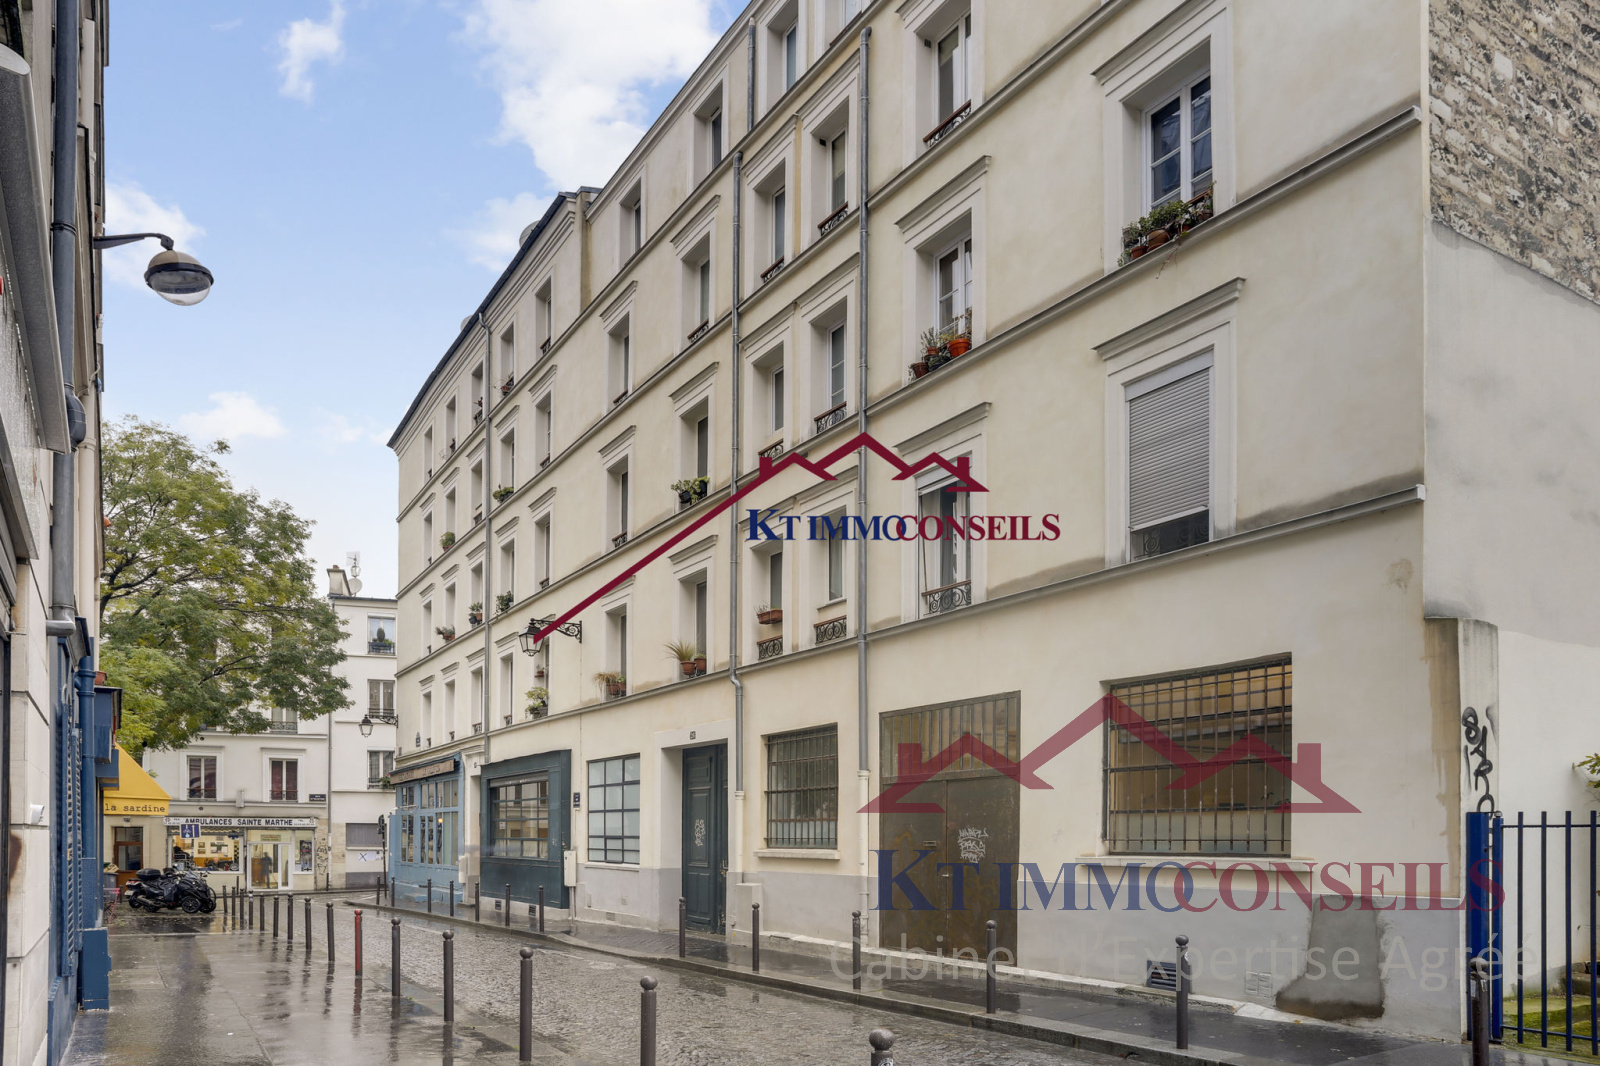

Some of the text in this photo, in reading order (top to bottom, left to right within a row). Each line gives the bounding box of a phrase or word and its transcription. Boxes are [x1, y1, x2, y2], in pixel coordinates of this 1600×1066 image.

[105, 803, 165, 812] la sardine
[185, 818, 232, 826] AMBULANCES
